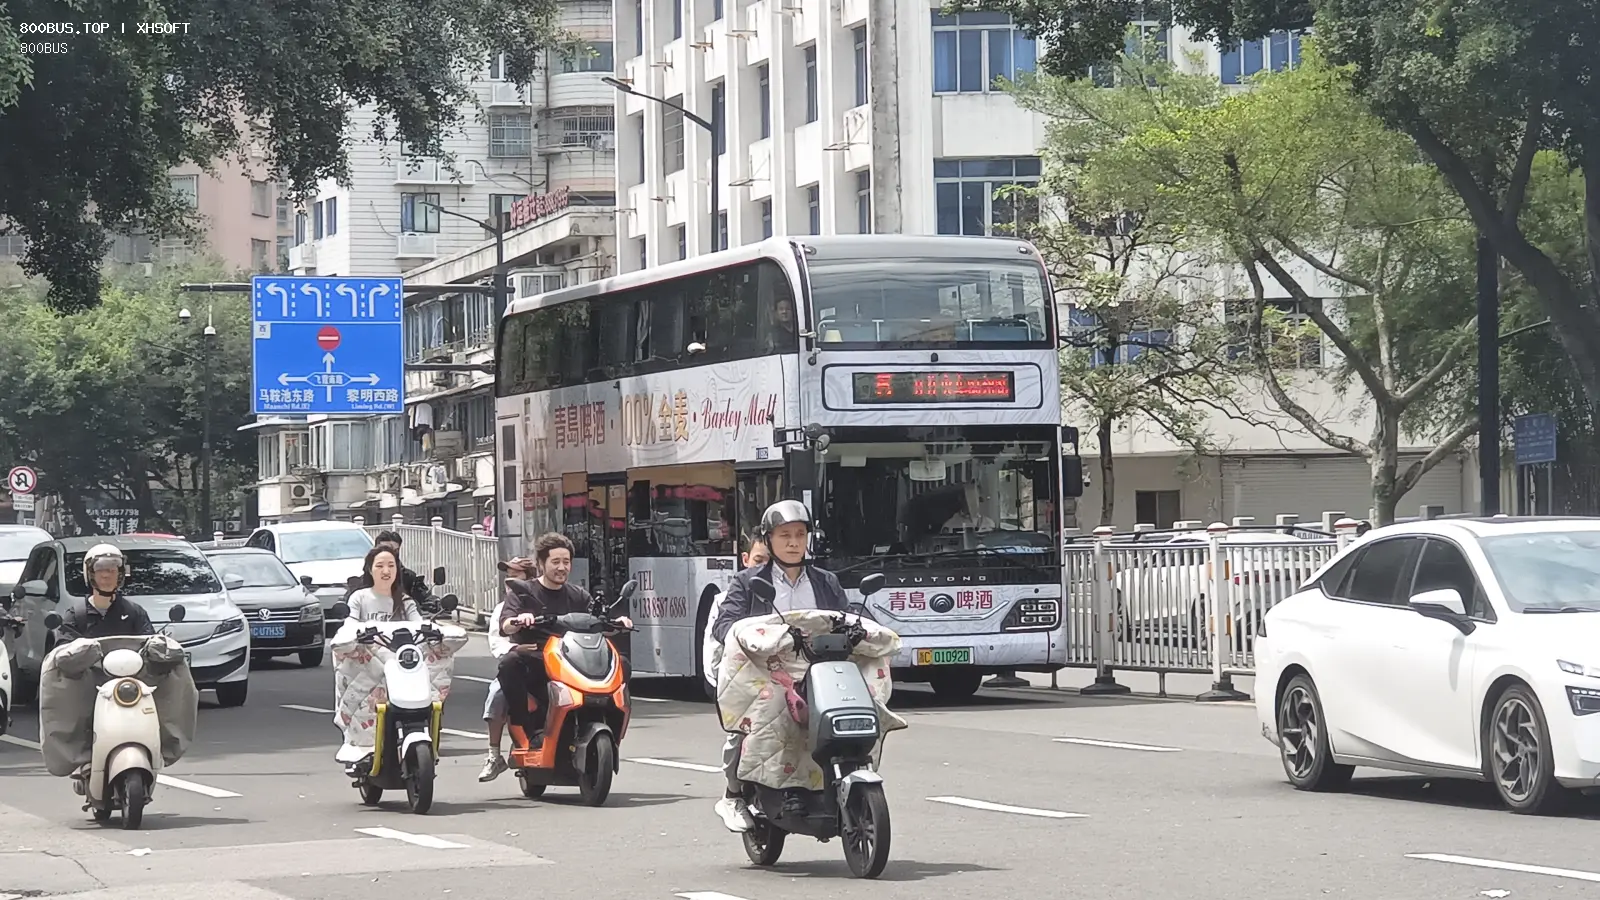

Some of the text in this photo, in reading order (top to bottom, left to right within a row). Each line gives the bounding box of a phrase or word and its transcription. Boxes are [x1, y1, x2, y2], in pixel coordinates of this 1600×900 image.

[259, 388, 315, 403] 马鞍池东路
[346, 388, 398, 403] 黎明西路
[701, 397, 742, 441] Barley
[638, 570, 654, 591] TEL
[898, 575, 987, 583] YUTONG
[639, 597, 651, 618] 133
[956, 590, 993, 610] 啤酒
